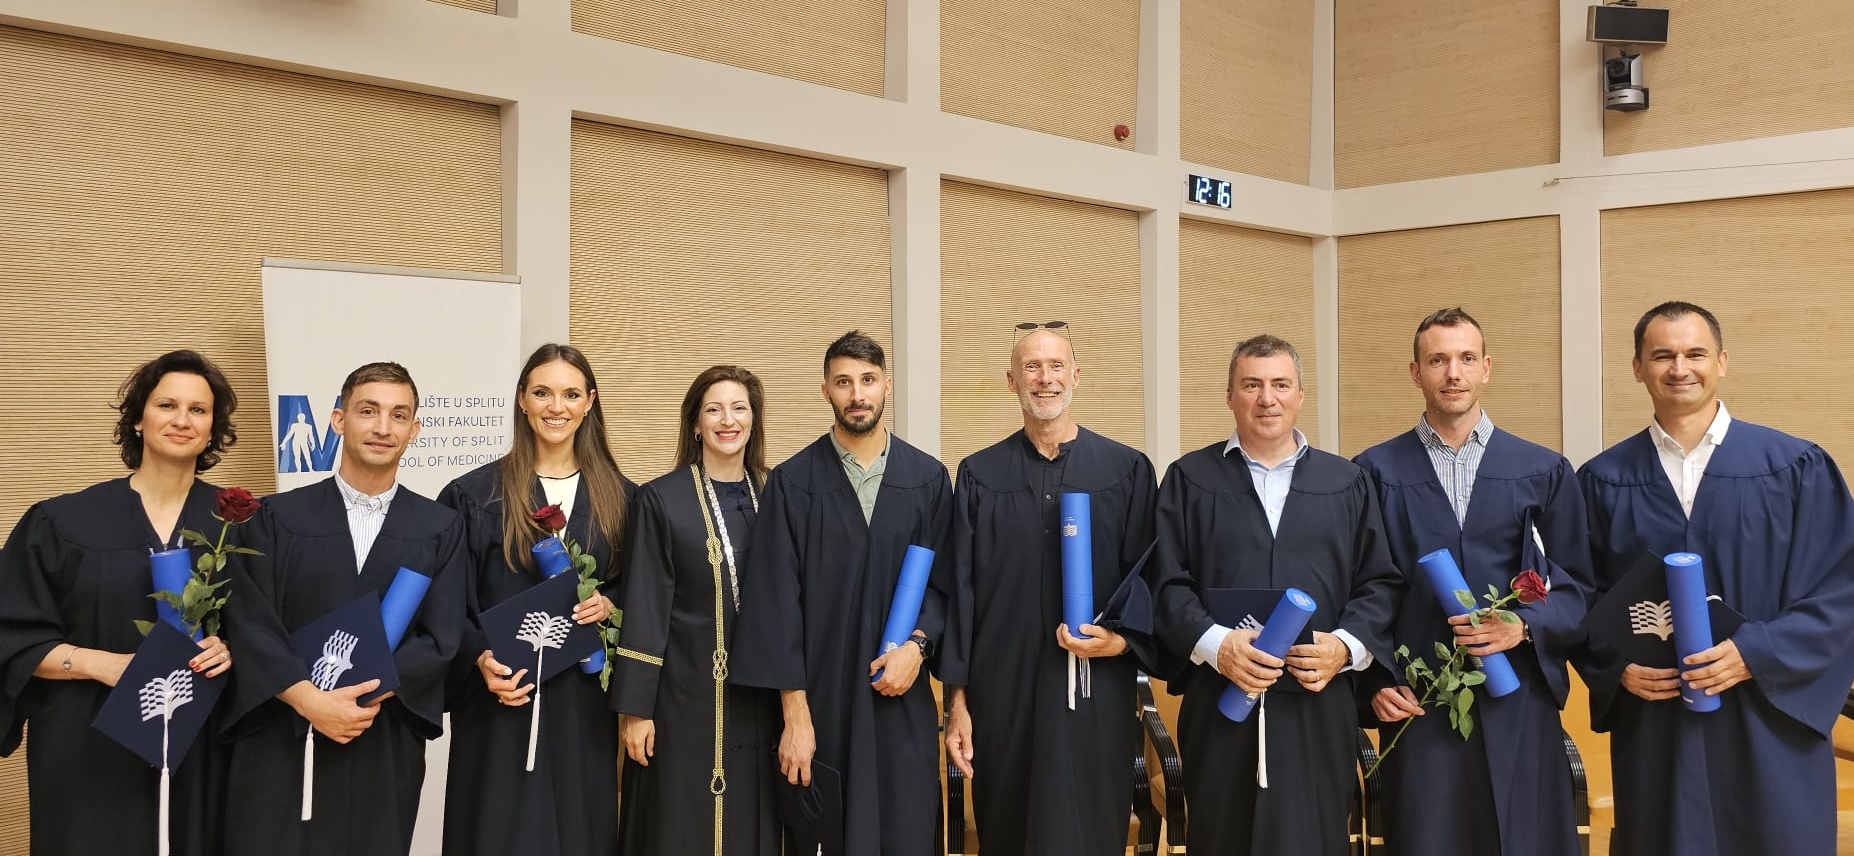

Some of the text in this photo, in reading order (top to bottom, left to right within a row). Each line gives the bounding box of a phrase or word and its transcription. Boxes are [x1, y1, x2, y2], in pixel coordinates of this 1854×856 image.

[1195, 177, 1231, 208] 12:16
[454, 397, 462, 408] U
[466, 397, 505, 408] SPLITU
[417, 416, 504, 428] NSKI FAKULTET
[410, 435, 505, 448] RSITY OF SPLIT
[399, 457, 425, 468] OOL
[427, 456, 446, 467] OF
